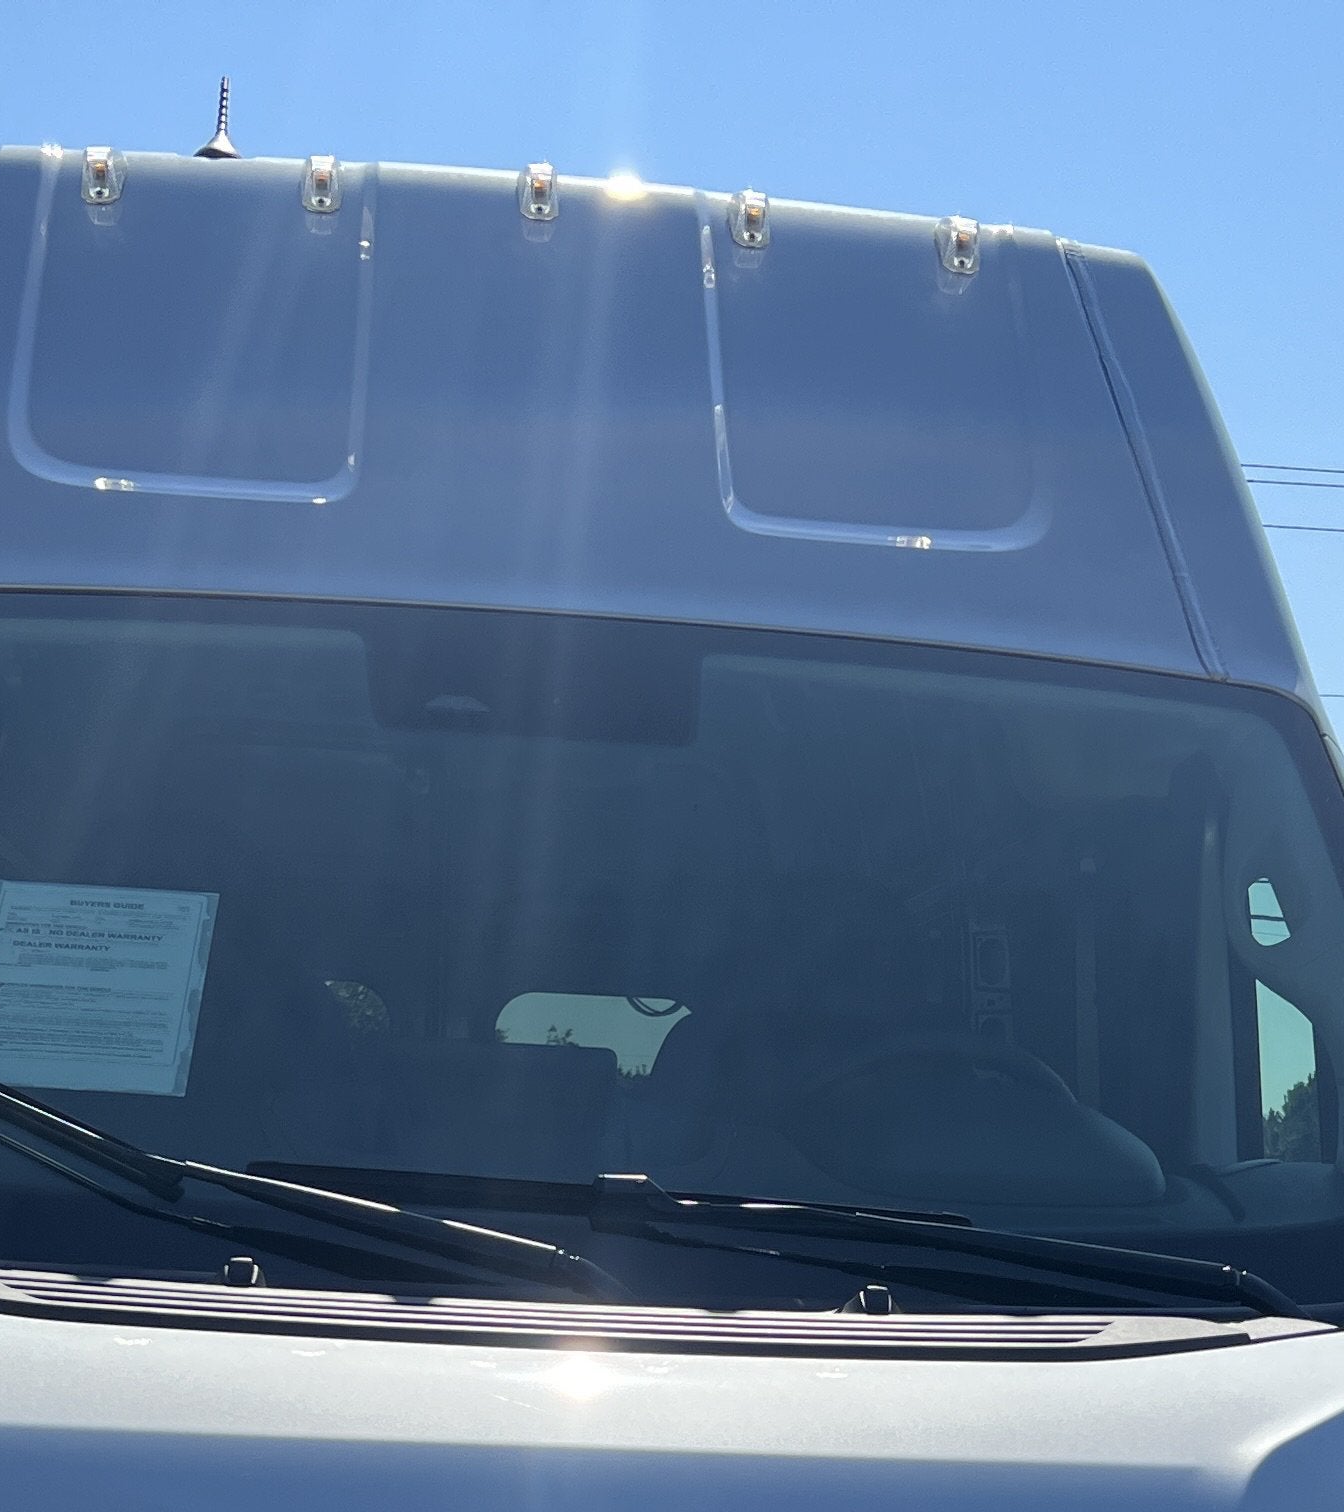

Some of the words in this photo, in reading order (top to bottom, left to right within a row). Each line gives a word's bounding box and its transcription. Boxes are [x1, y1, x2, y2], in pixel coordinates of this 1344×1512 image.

[66, 930, 106, 939] DEALER
[107, 932, 164, 942] WARRANTY
[12, 940, 53, 949] DEALER
[54, 942, 111, 952] WARRANTY
